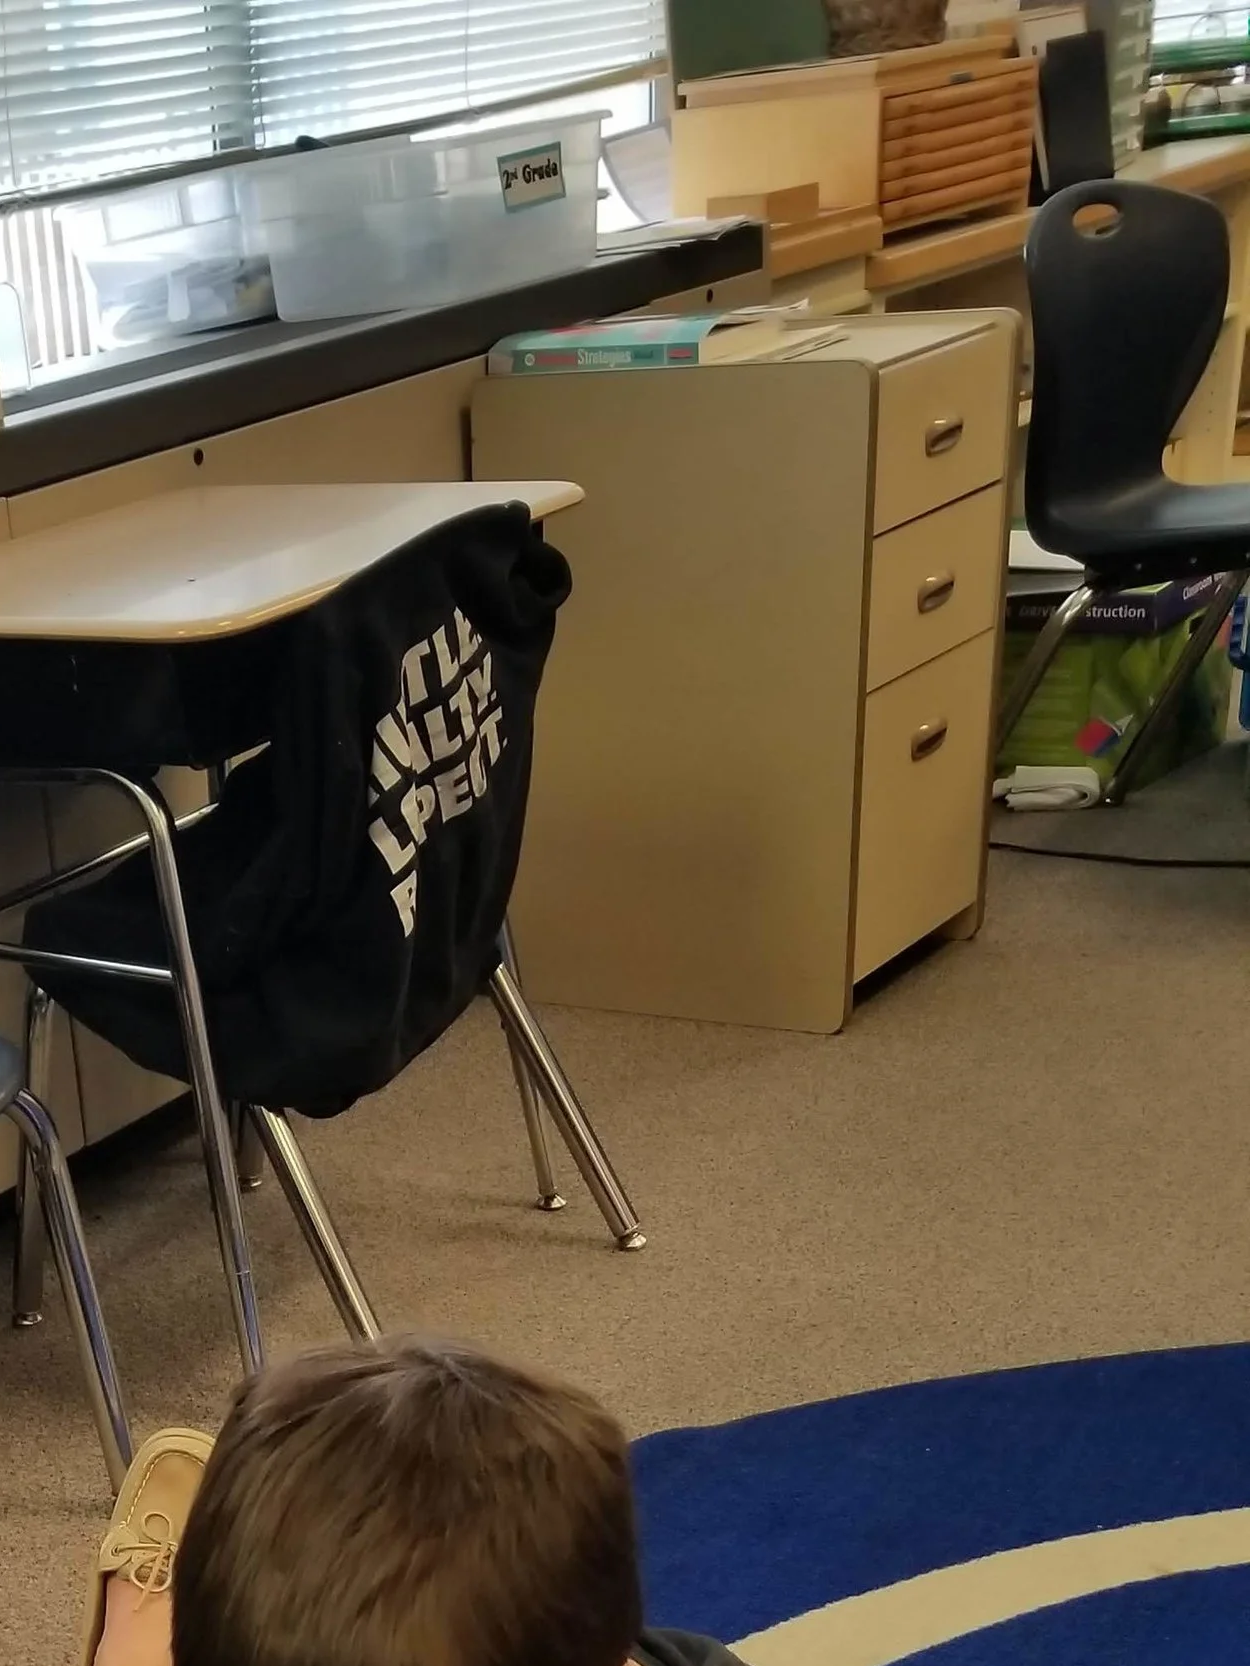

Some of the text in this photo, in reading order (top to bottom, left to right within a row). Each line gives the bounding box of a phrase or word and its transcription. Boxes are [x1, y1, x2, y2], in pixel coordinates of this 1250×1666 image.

[522, 158, 559, 184] Grade
[577, 348, 632, 366] Strategies
[1085, 603, 1147, 619] struction
